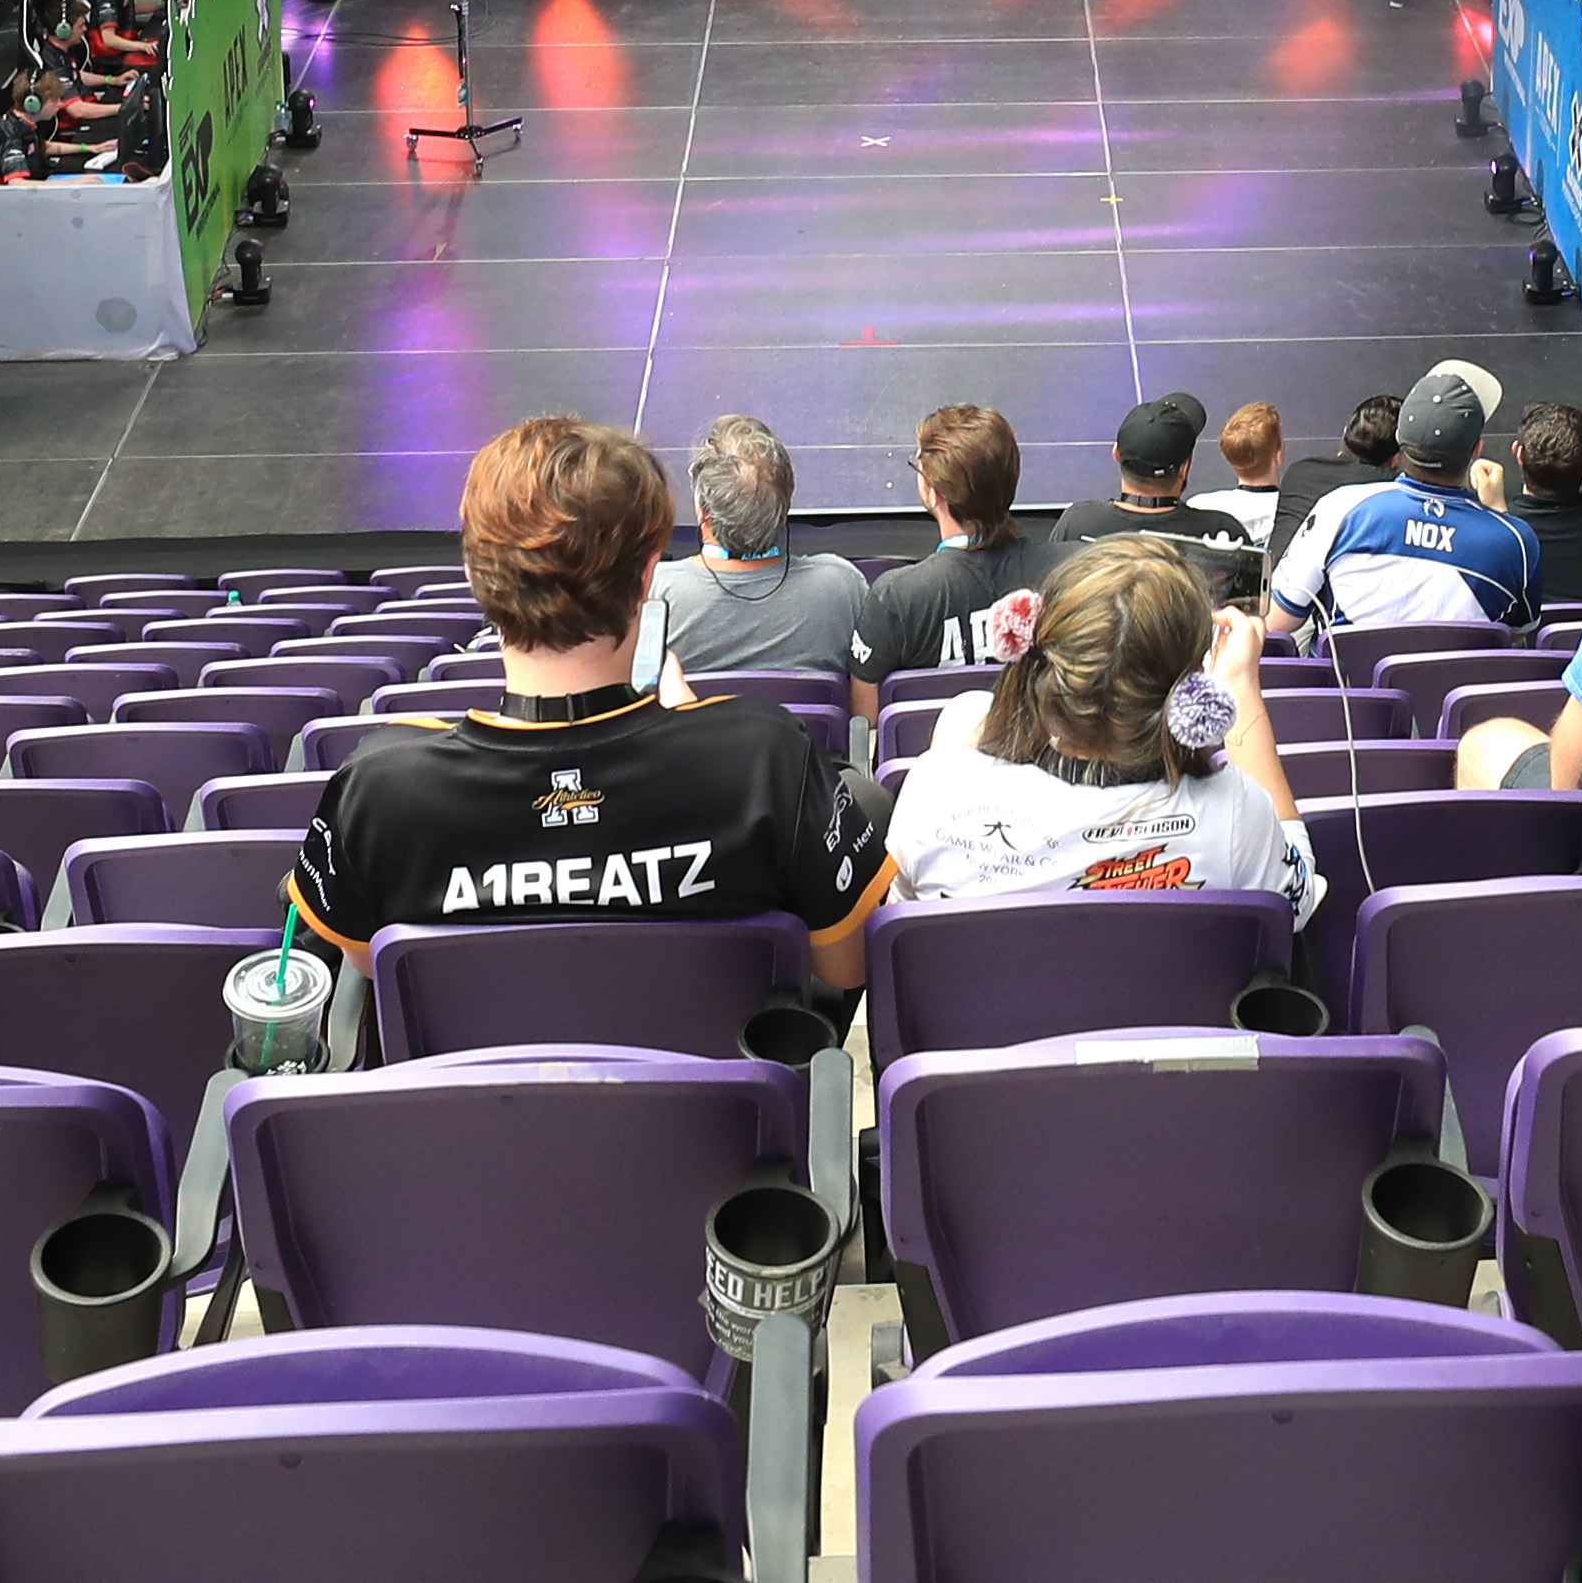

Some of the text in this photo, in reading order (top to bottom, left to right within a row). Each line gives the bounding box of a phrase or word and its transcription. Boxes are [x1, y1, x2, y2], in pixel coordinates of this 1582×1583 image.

[1405, 519, 1455, 552] NOX
[935, 827, 977, 851] GAME
[1023, 855, 1036, 867] &
[1077, 843, 1169, 886] STREET
[442, 840, 716, 915] A1BEATZ
[992, 864, 1026, 878] YORK
